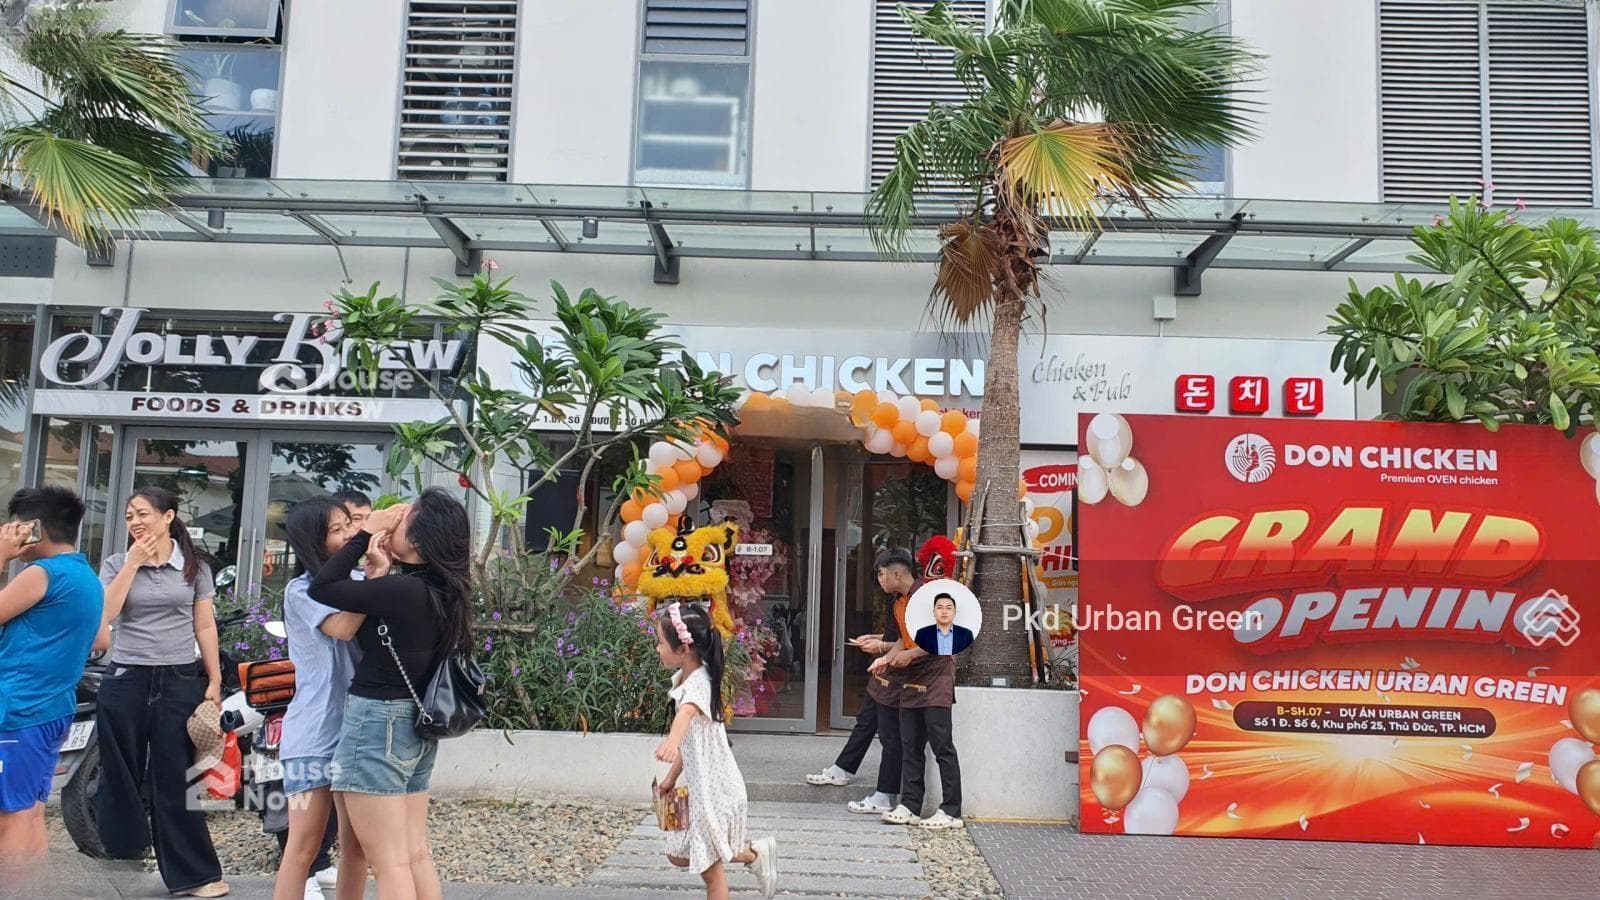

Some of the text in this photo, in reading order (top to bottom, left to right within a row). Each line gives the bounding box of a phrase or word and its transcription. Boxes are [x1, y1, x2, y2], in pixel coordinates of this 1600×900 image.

[744, 353, 985, 397] CHICKEN
[1032, 353, 1106, 383] Chicken
[1072, 371, 1131, 401] & Pub
[131, 396, 221, 414] FOODS
[232, 398, 250, 414] &
[260, 398, 364, 417] DRINKS
[1284, 443, 1498, 471] DON CHICKEN
[1380, 473, 1498, 486] Premium OVEN chicken
[1160, 506, 1541, 587] GRAND
[1233, 586, 1569, 644] OPENING
[1185, 669, 1568, 707] DON CHICKEN URBAN GREEN
[1254, 716, 1269, 727] Số
[1279, 718, 1292, 728] Đ.
[1294, 718, 1308, 728] Số
[1310, 719, 1320, 730] 6,
[1323, 719, 1344, 729] Khu
[1346, 719, 1368, 732] phố
[1370, 721, 1386, 732] 25,
[1389, 720, 1409, 731] Thủ
[1412, 721, 1438, 733] Đức,
[1440, 723, 1456, 733] TP.
[1459, 723, 1486, 734] HCM
[1276, 705, 1323, 716] B-SH.07
[1339, 707, 1357, 720] DỰ
[1359, 706, 1376, 718] ÁN
[1379, 708, 1419, 719] URBAN
[1422, 710, 1461, 721] GREEN
